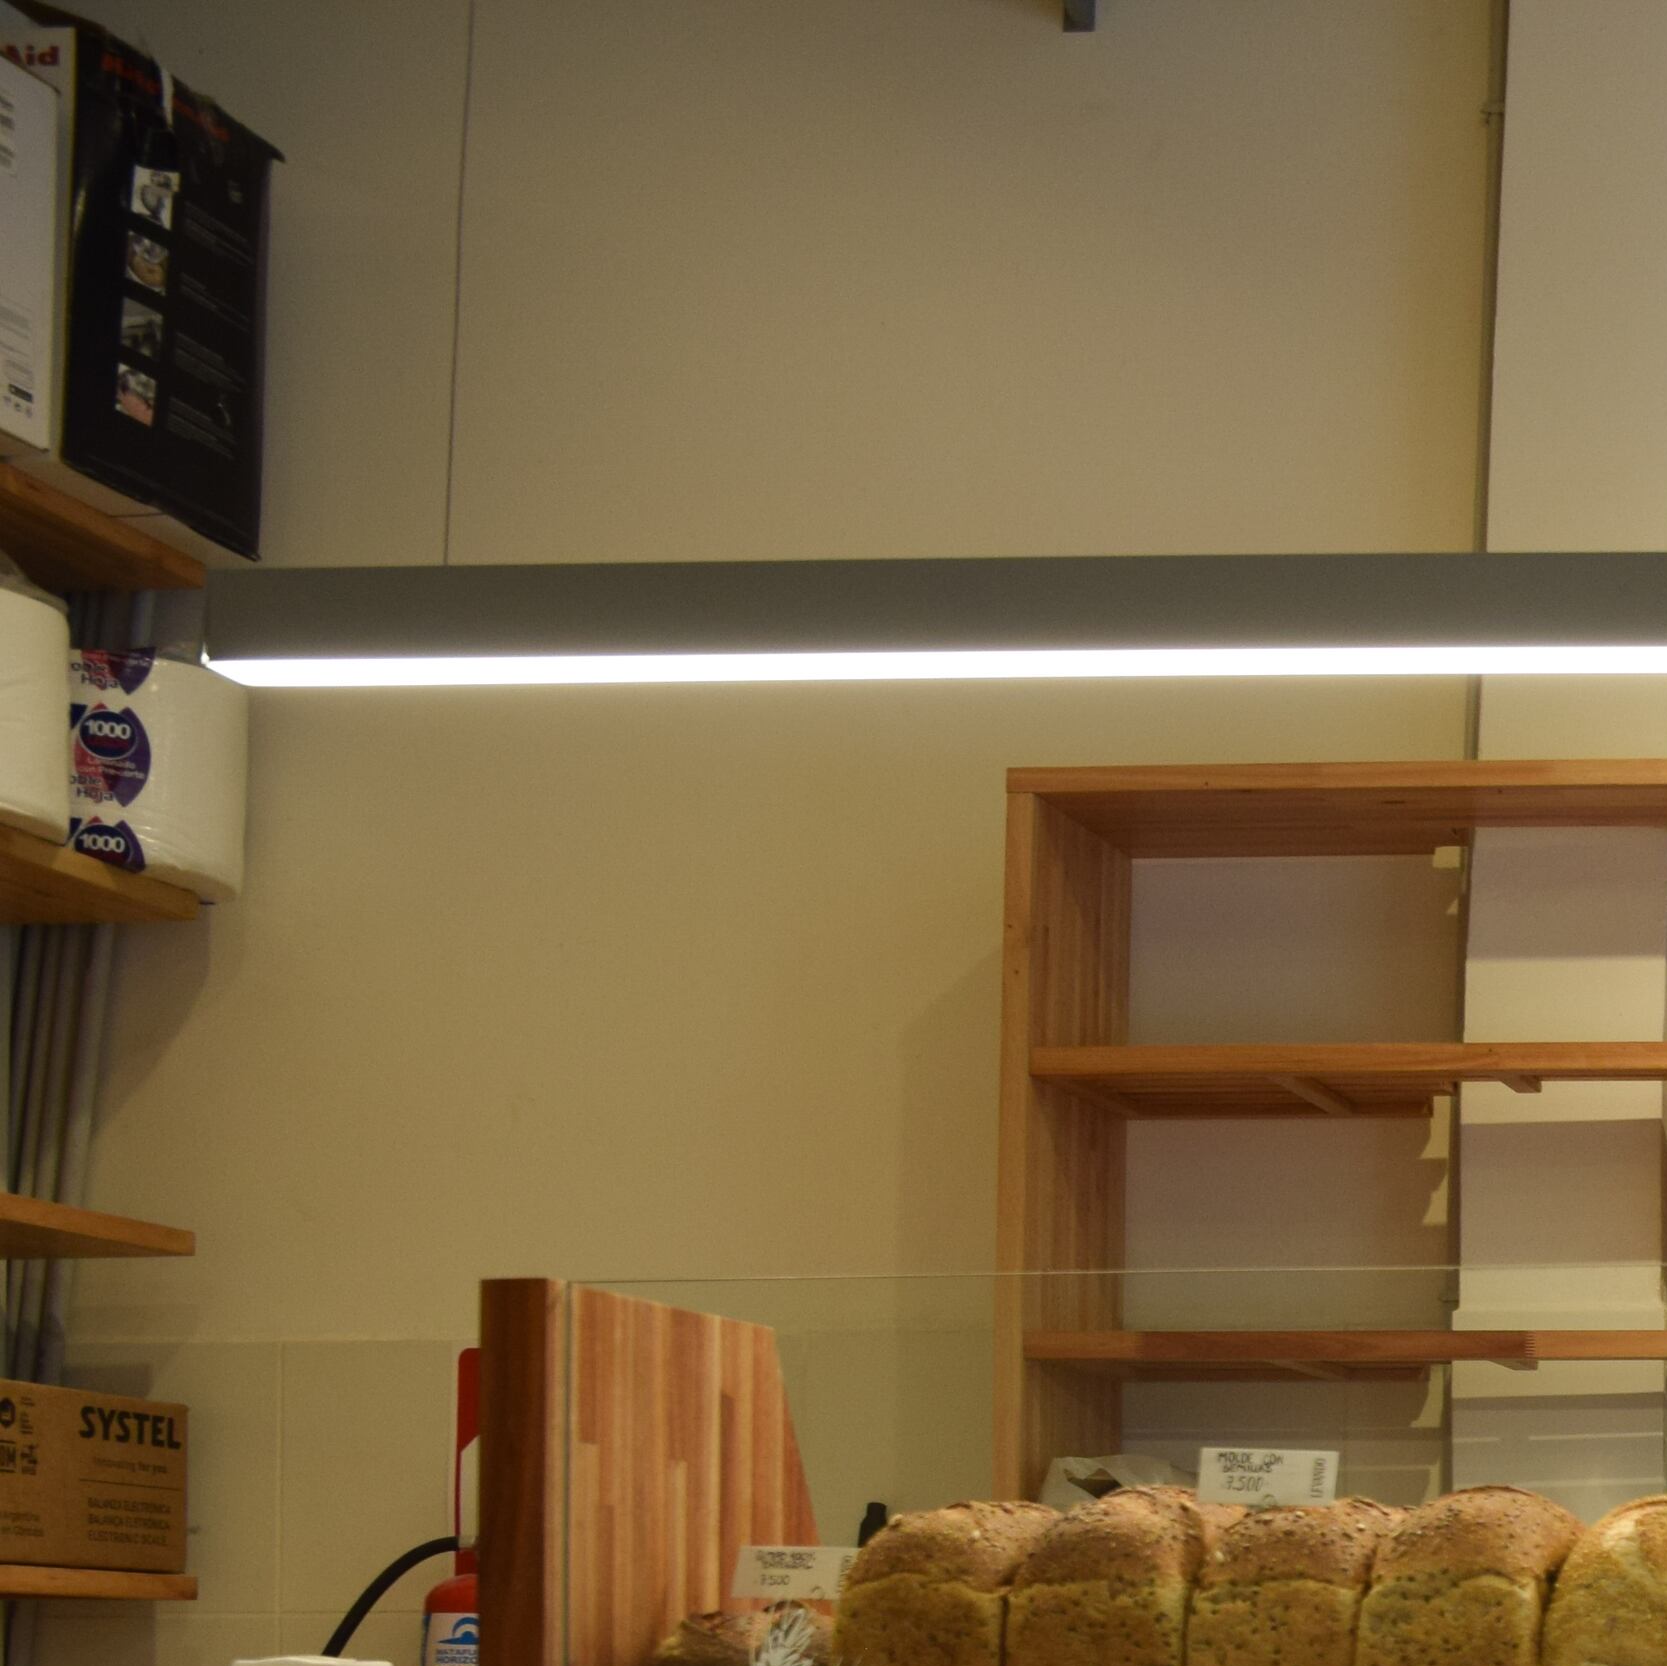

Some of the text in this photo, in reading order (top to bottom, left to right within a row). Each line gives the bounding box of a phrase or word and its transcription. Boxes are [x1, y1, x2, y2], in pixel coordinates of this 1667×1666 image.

[86, 719, 131, 740] 1000
[80, 834, 125, 852] 1000
[79, 1405, 182, 1449] SYSTEL
[1310, 1457, 1327, 1499] LEVANDO
